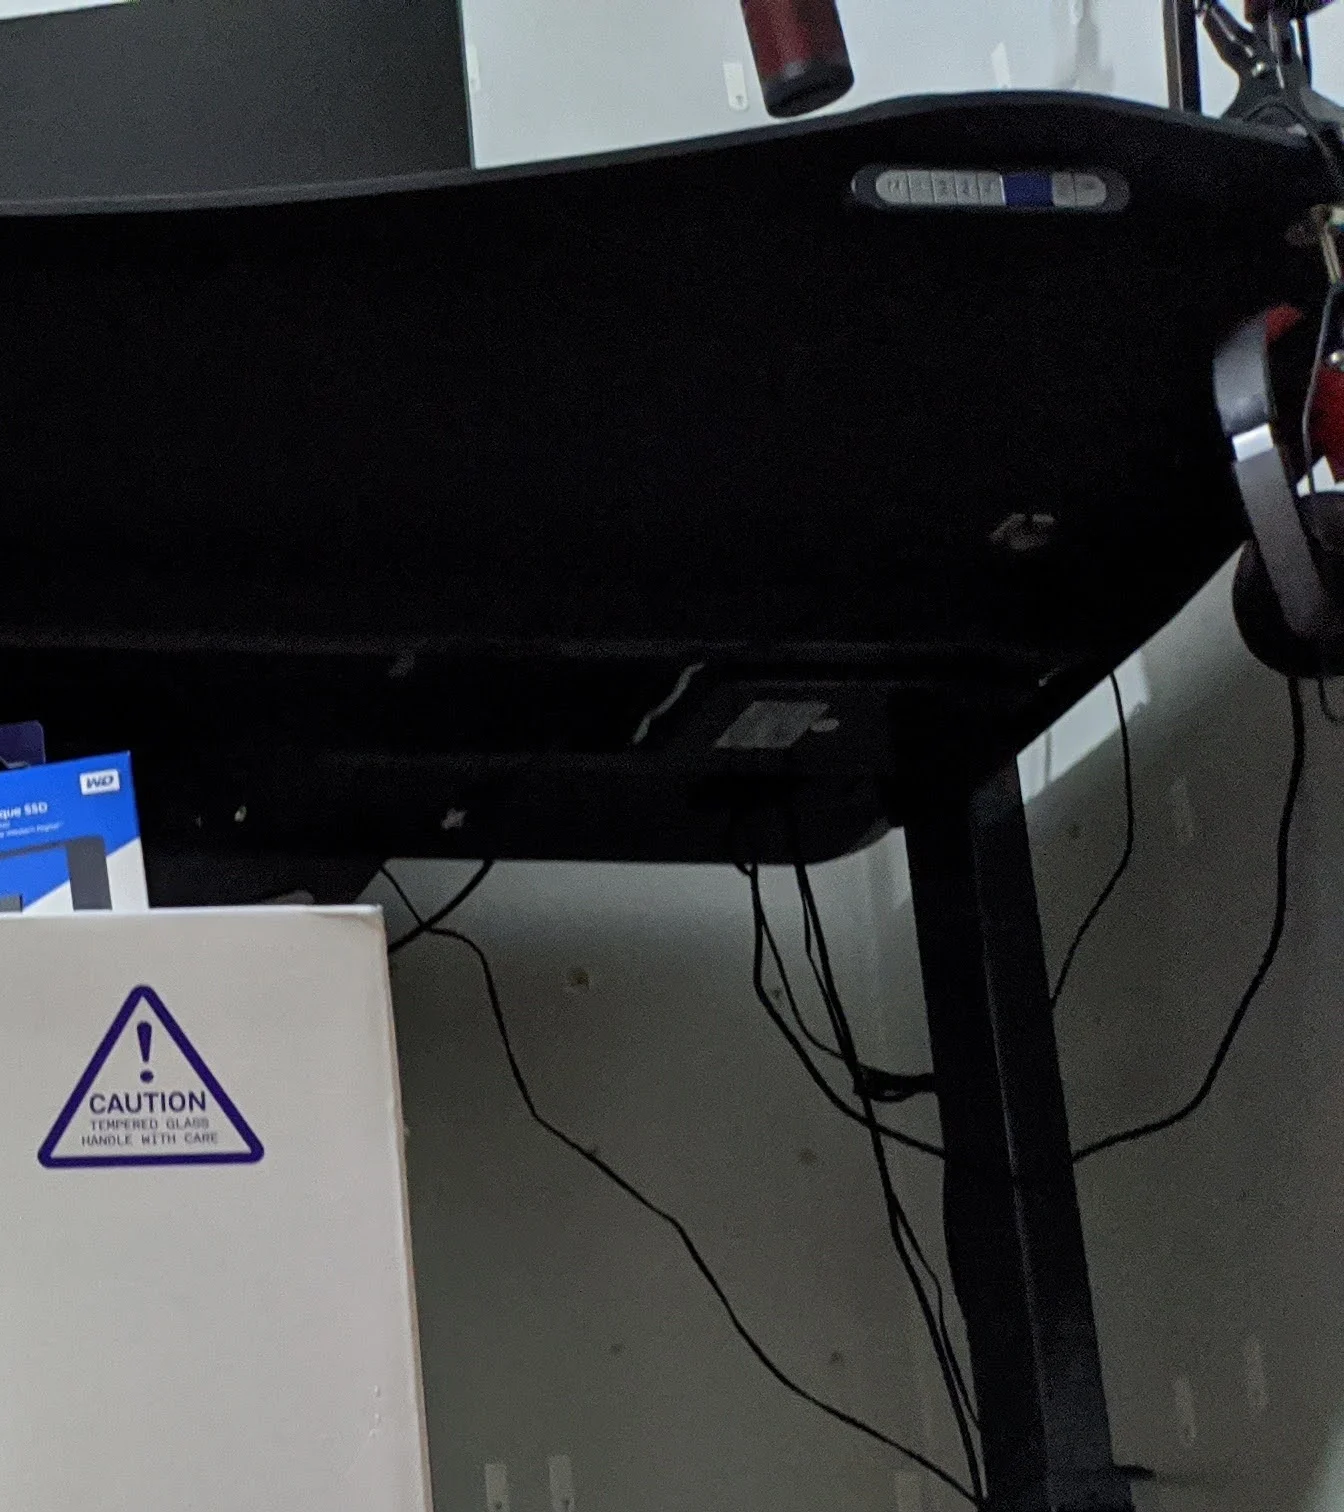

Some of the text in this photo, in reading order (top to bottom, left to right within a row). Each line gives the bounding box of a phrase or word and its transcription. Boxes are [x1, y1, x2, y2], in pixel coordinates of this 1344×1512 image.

[85, 774, 115, 790] WD
[24, 801, 48, 817] SSD
[89, 1091, 206, 1114] CAUTION
[90, 1117, 210, 1131] TEMPERED GLASS
[81, 1132, 218, 1146] HANDLE WITH CARE
